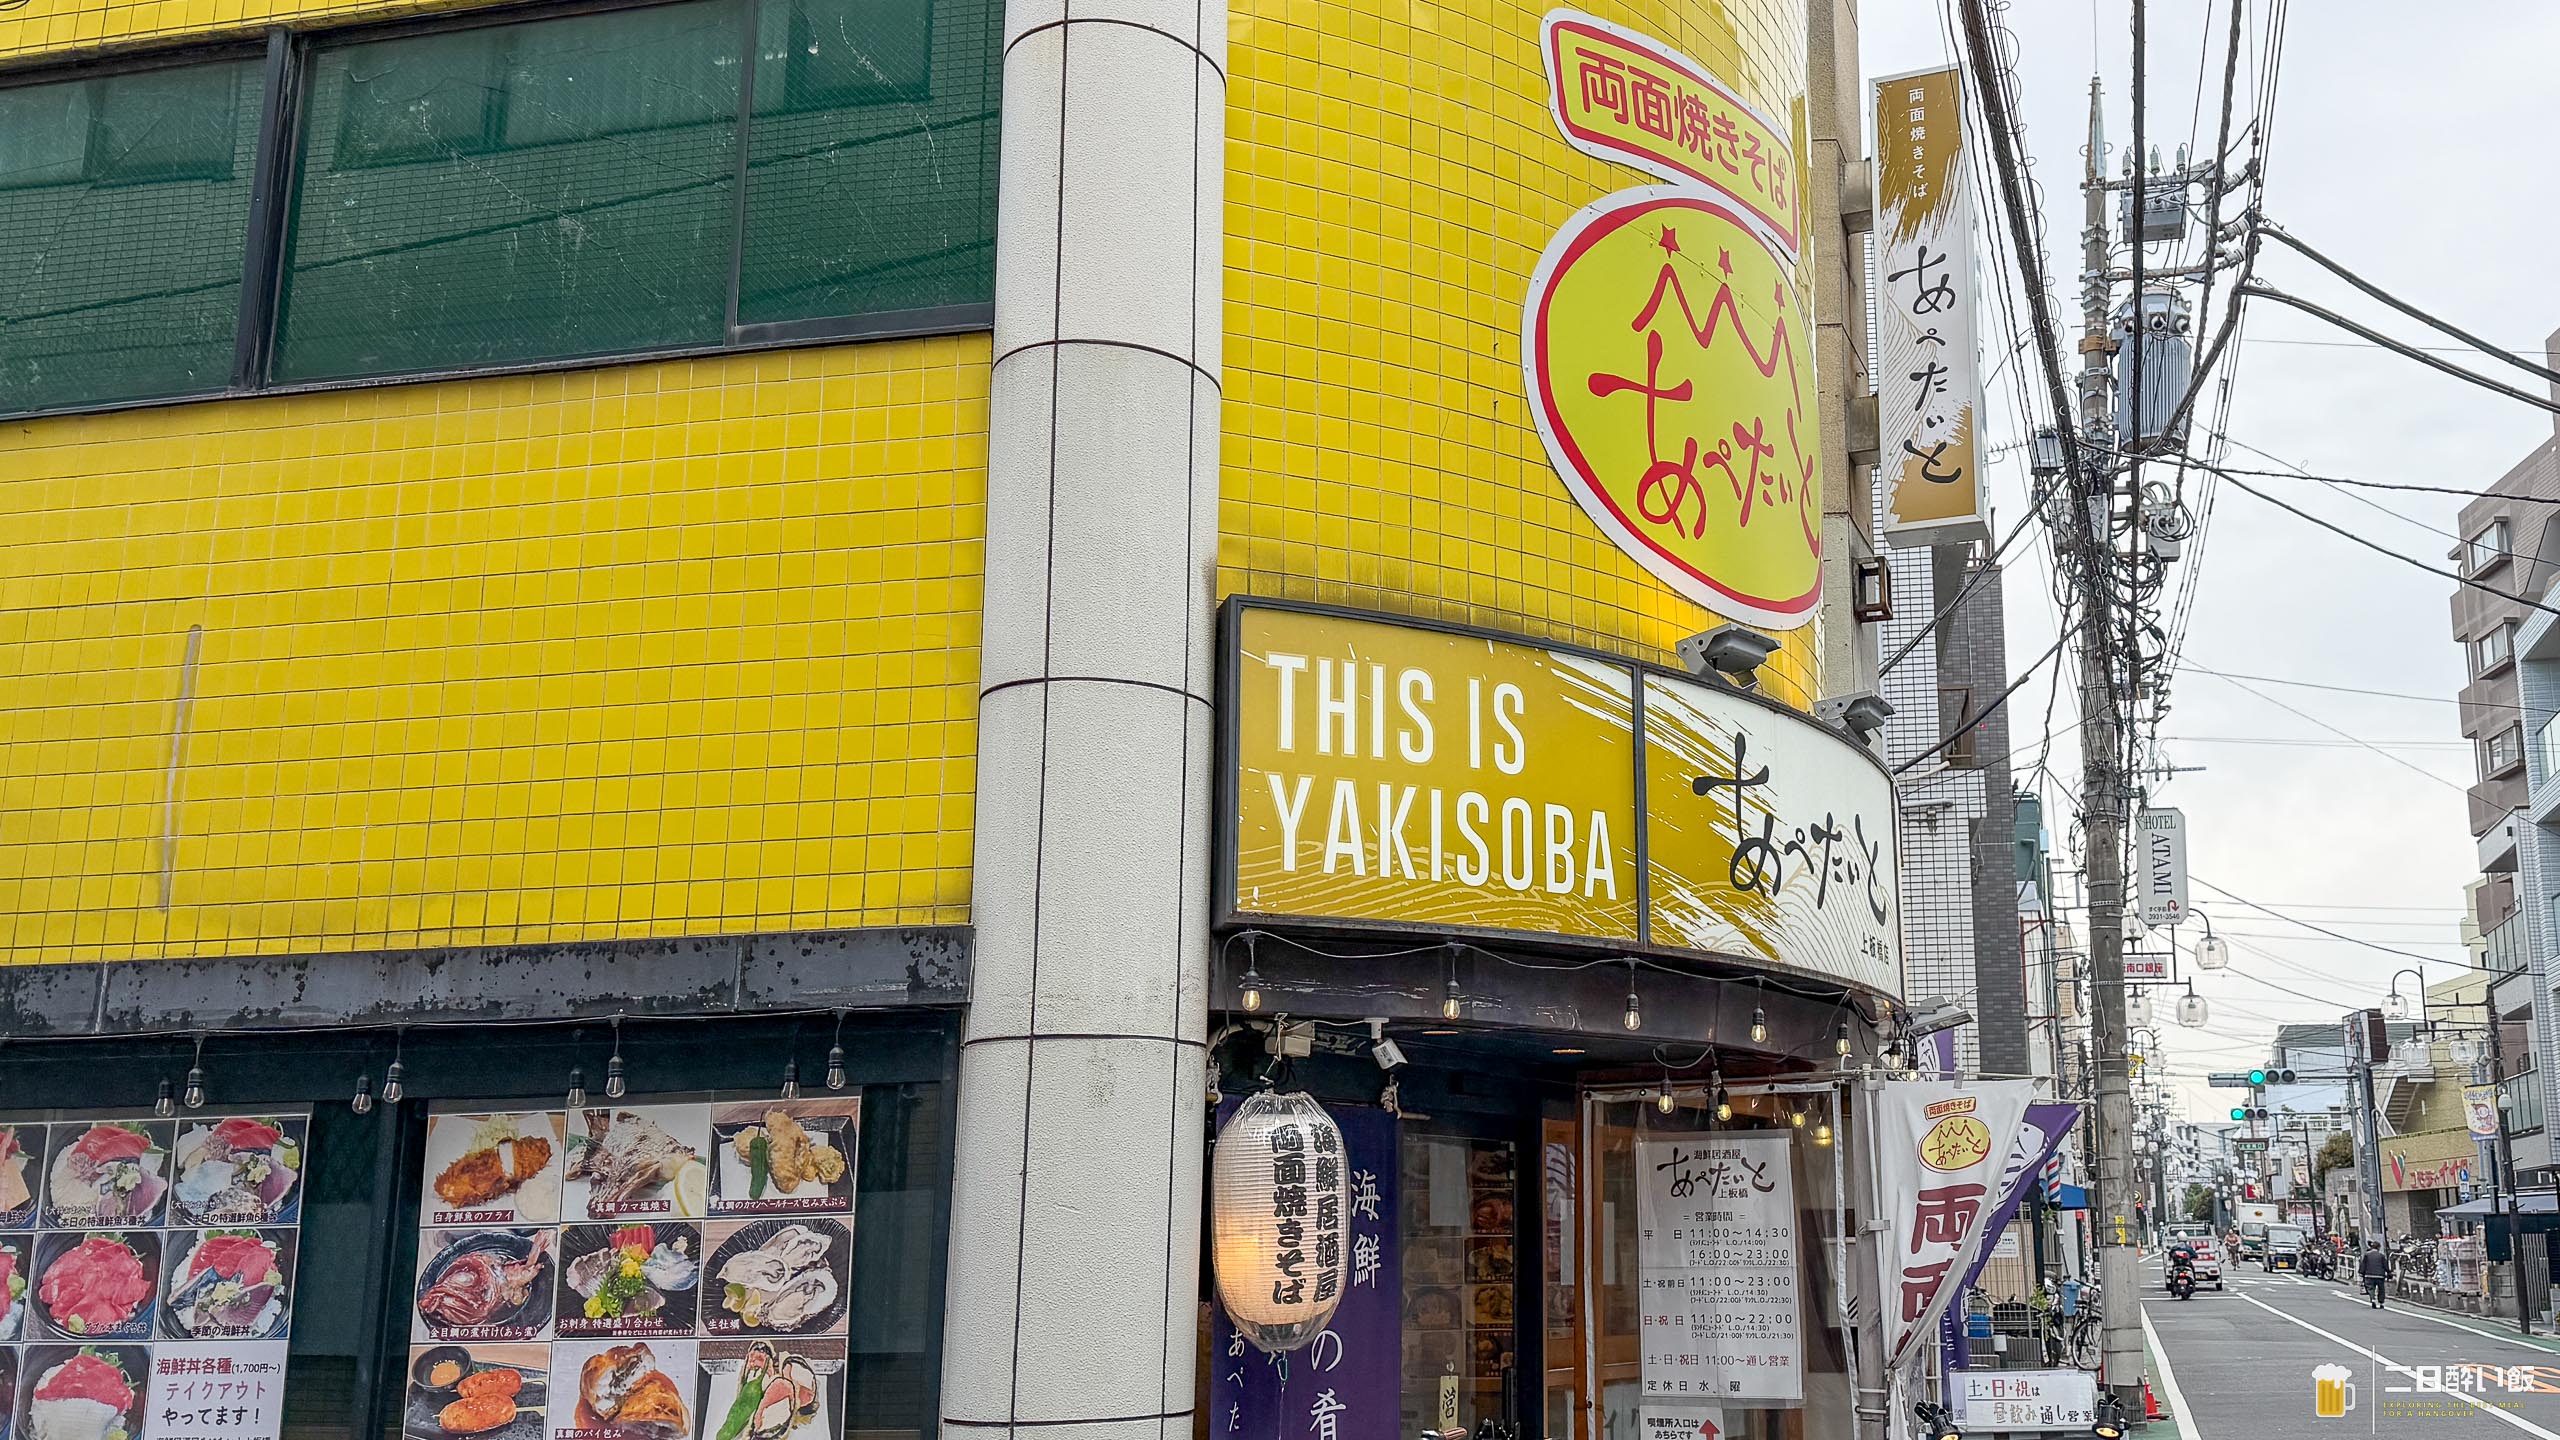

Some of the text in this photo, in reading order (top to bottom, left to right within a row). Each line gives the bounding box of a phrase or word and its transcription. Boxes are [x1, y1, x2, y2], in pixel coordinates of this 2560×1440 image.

[1575, 46, 1792, 210] 両面焼きそば
[1907, 87, 1929, 200] 両面焼きそば
[1888, 244, 1962, 485] あぺたいと
[1587, 329, 1821, 560] あぺたいと
[1266, 652, 1526, 776] THIS IS
[1267, 772, 1617, 901] YAKISOBA
[1692, 731, 1888, 927] あぺたいと
[2144, 814, 2177, 830] HOTEL
[2151, 832, 2173, 896] ATAMI
[1861, 930, 1889, 966] 上板橋店
[1928, 1099, 1972, 1116] 両面焼きそば
[1693, 1148, 1741, 1161] 海鮮居酒屋
[1928, 1136, 1986, 1167] あぺたいと
[1656, 1147, 1776, 1198] あぺたいと
[618, 1200, 671, 1213] カマ塩焼き
[1718, 1188, 1749, 1199] 上板橋
[434, 1210, 513, 1224] 白身鮮魚のフライ
[1271, 1123, 1308, 1306] 両面焼きそば
[1308, 1122, 1340, 1304] 海鮮居酒屋
[1695, 1211, 1733, 1222] 営業時間
[190, 1324, 251, 1337] 季節の海鮮丼
[166, 1380, 266, 1401] テイクアウト
[162, 1405, 260, 1427] やってます！
[556, 1428, 622, 1439] 真鯛のパイ包み
